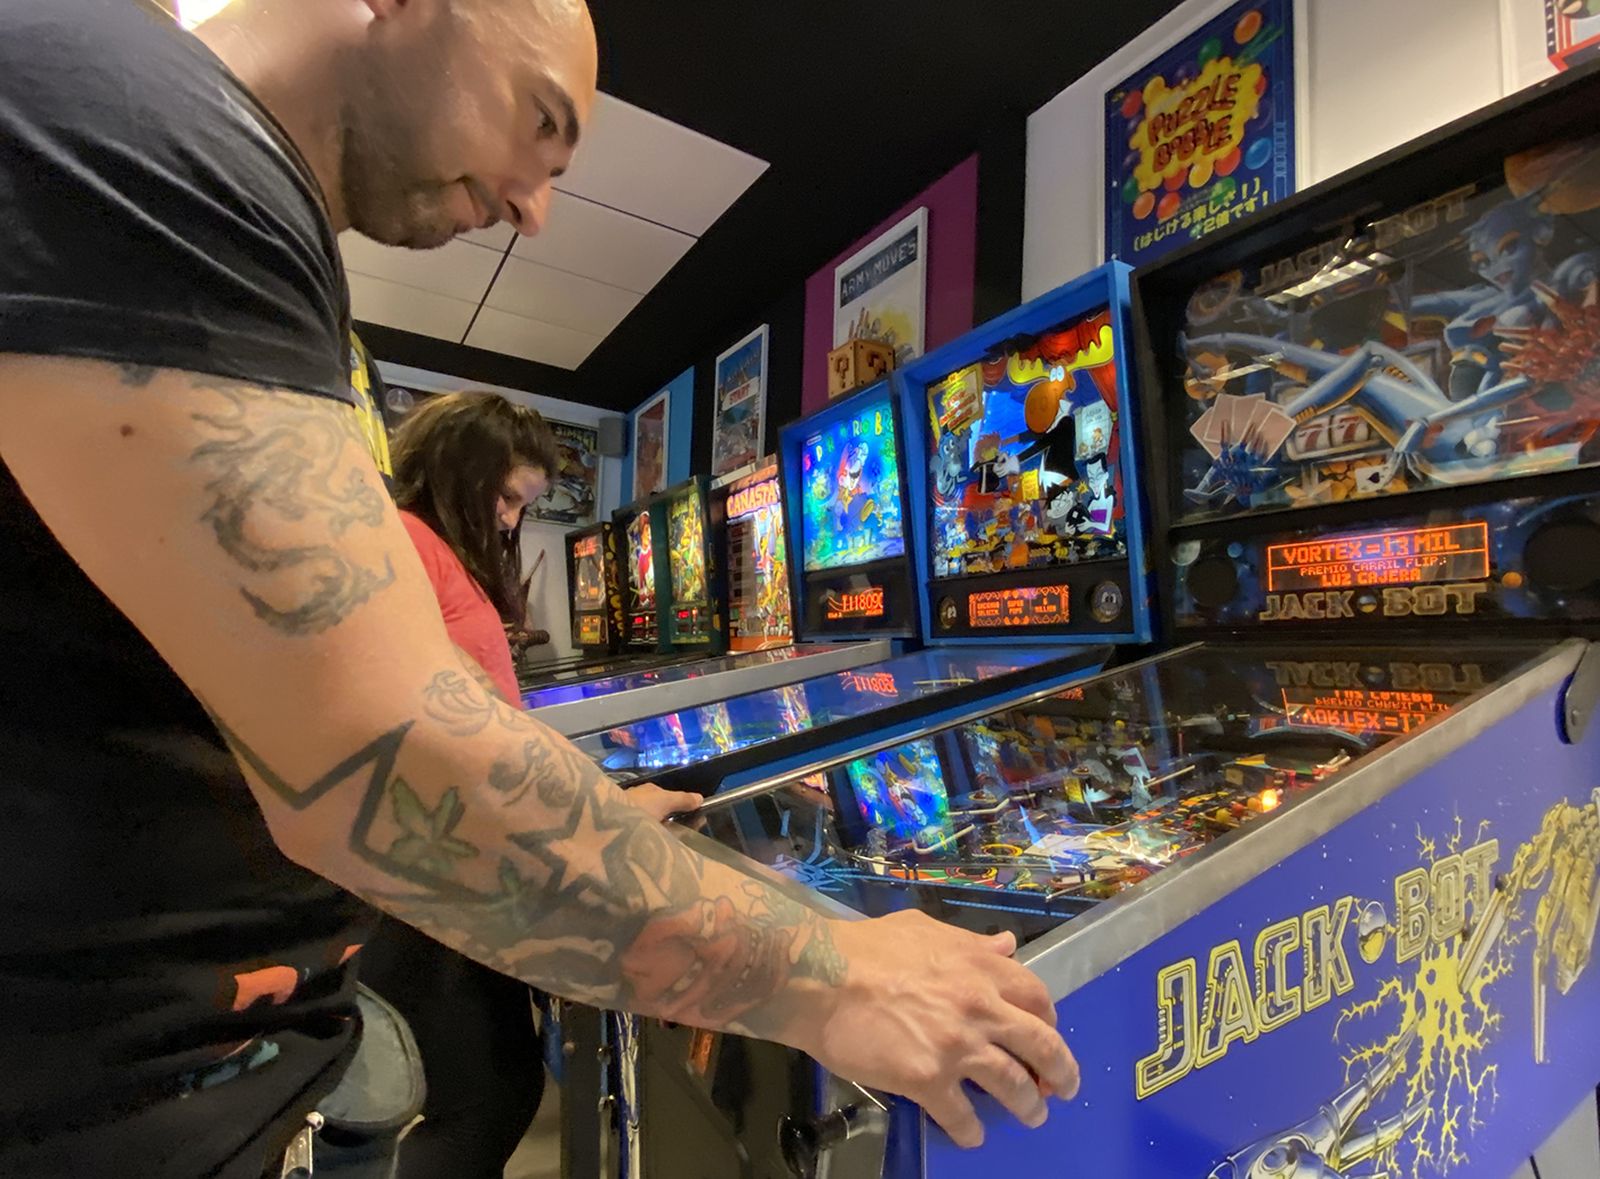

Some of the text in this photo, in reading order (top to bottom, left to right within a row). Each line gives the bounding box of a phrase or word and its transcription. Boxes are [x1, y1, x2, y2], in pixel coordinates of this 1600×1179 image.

[842, 238, 916, 297] ARMY MOVES
[727, 481, 777, 518] CANASTA
[1284, 541, 1362, 565] VORTEX
[1413, 531, 1460, 552] MIL
[1300, 563, 1347, 577] PREMIO
[1352, 560, 1400, 573] CARRIL
[1321, 567, 1421, 587] LUZ CAJERA
[1260, 583, 1487, 621] JACK BOT
[1135, 838, 1499, 1101] JACK BOT
